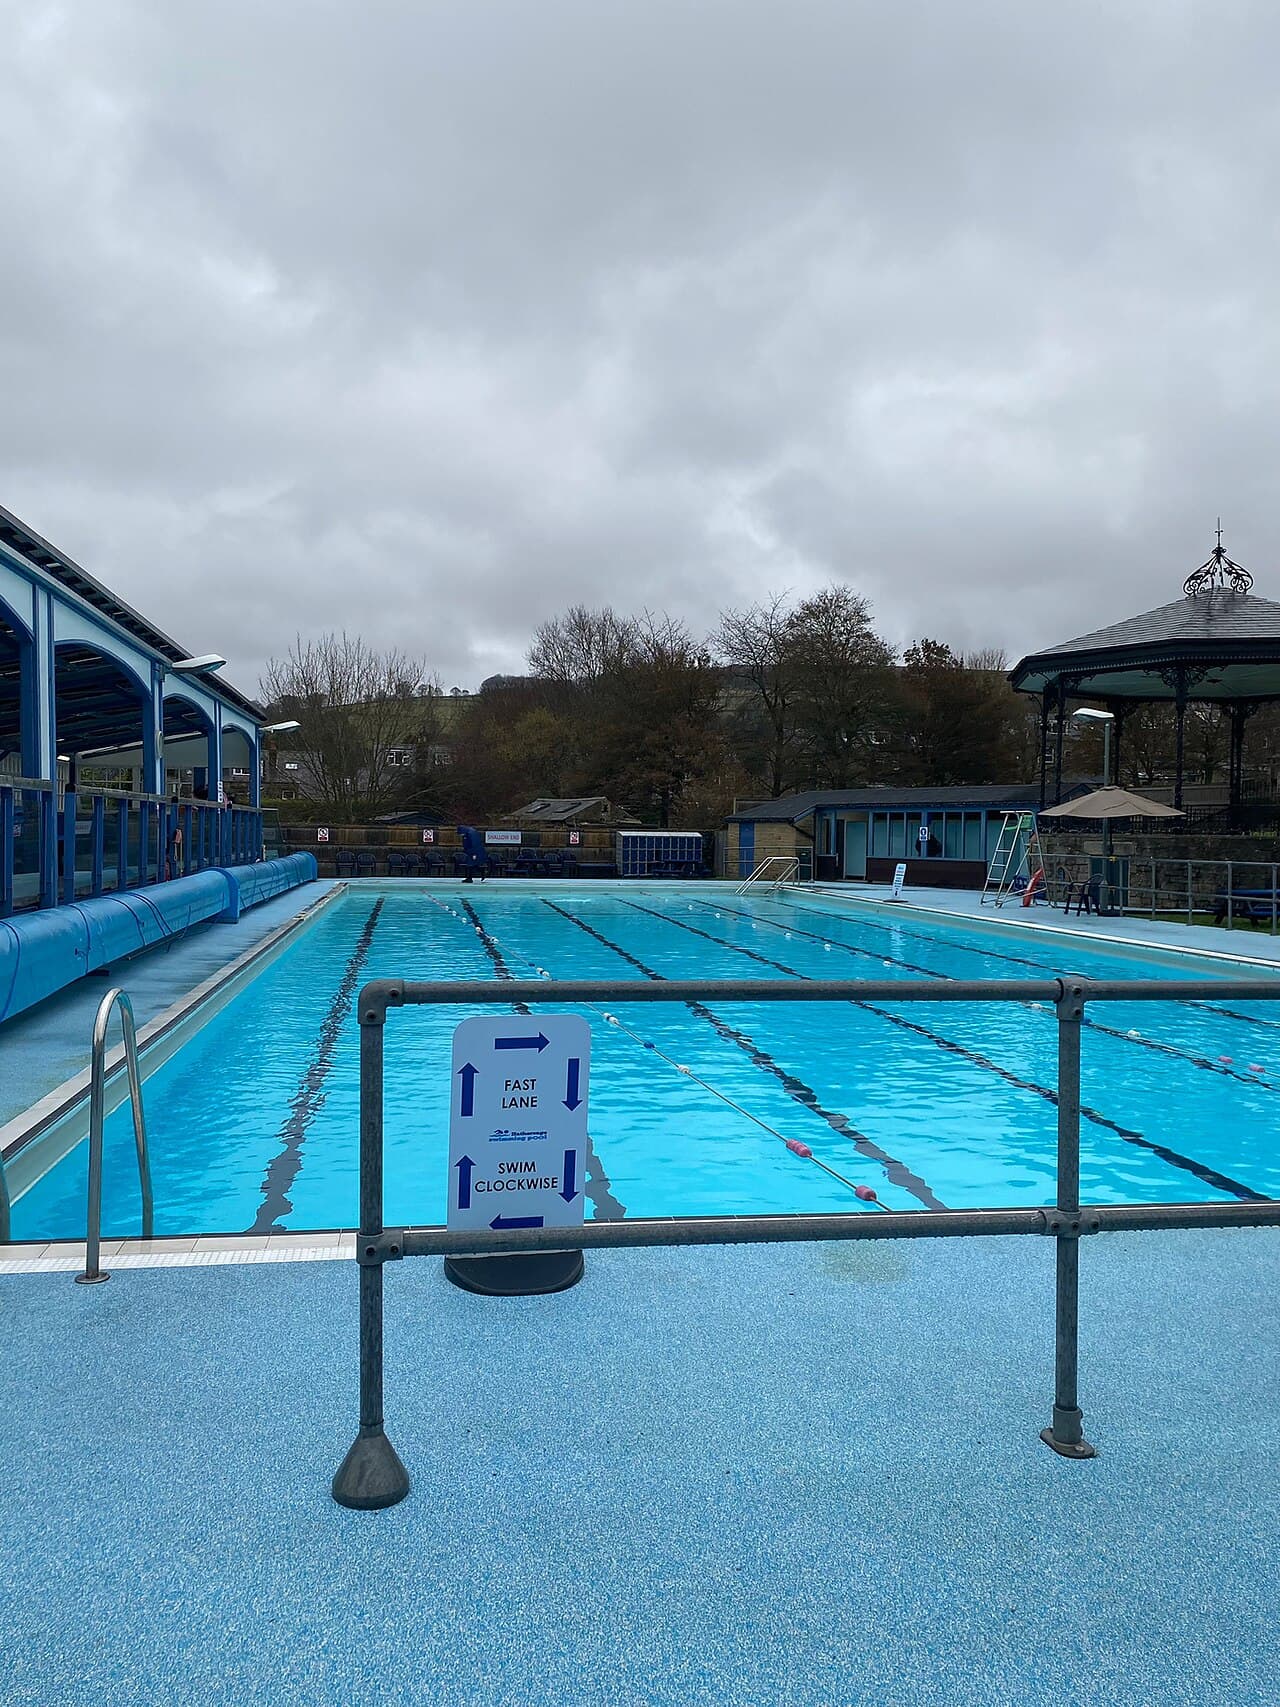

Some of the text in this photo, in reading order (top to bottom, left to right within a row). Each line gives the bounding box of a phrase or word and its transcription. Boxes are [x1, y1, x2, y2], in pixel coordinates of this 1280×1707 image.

[504, 1079, 537, 1091] FAST
[502, 1096, 538, 1109] LANE
[498, 1161, 537, 1174] SWIM
[475, 1177, 558, 1193] CLOCKWISE
